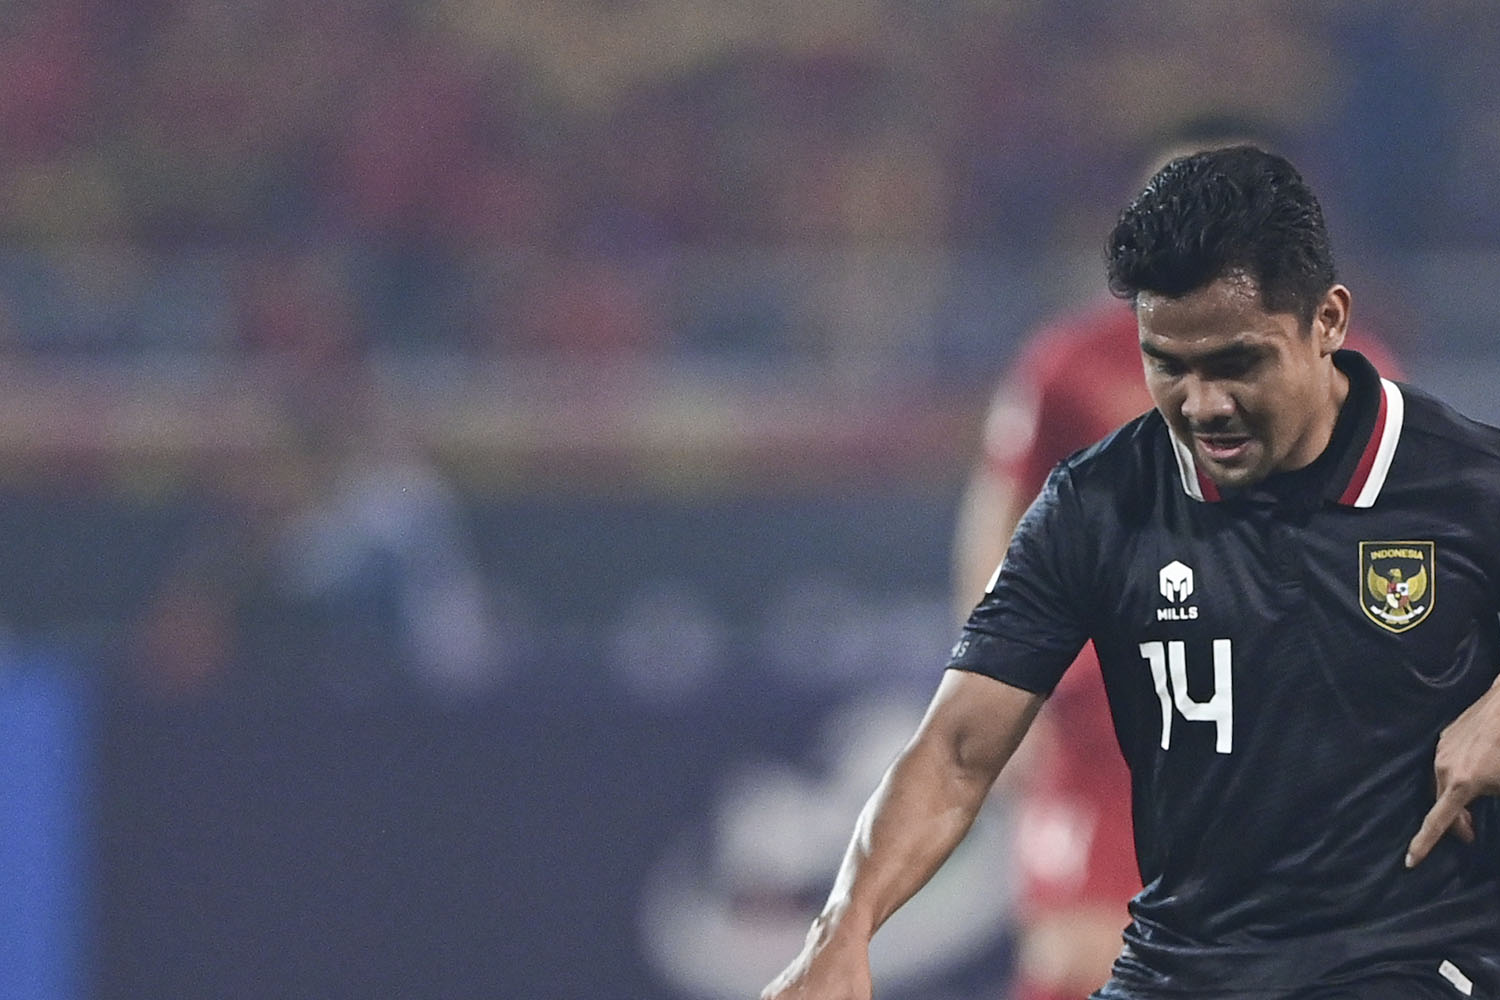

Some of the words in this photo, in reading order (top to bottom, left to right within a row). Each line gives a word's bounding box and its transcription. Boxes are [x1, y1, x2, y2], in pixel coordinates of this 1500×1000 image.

[1370, 549, 1424, 560] INDONESIA
[1157, 606, 1198, 621] MILLS
[1139, 639, 1233, 754] 14
